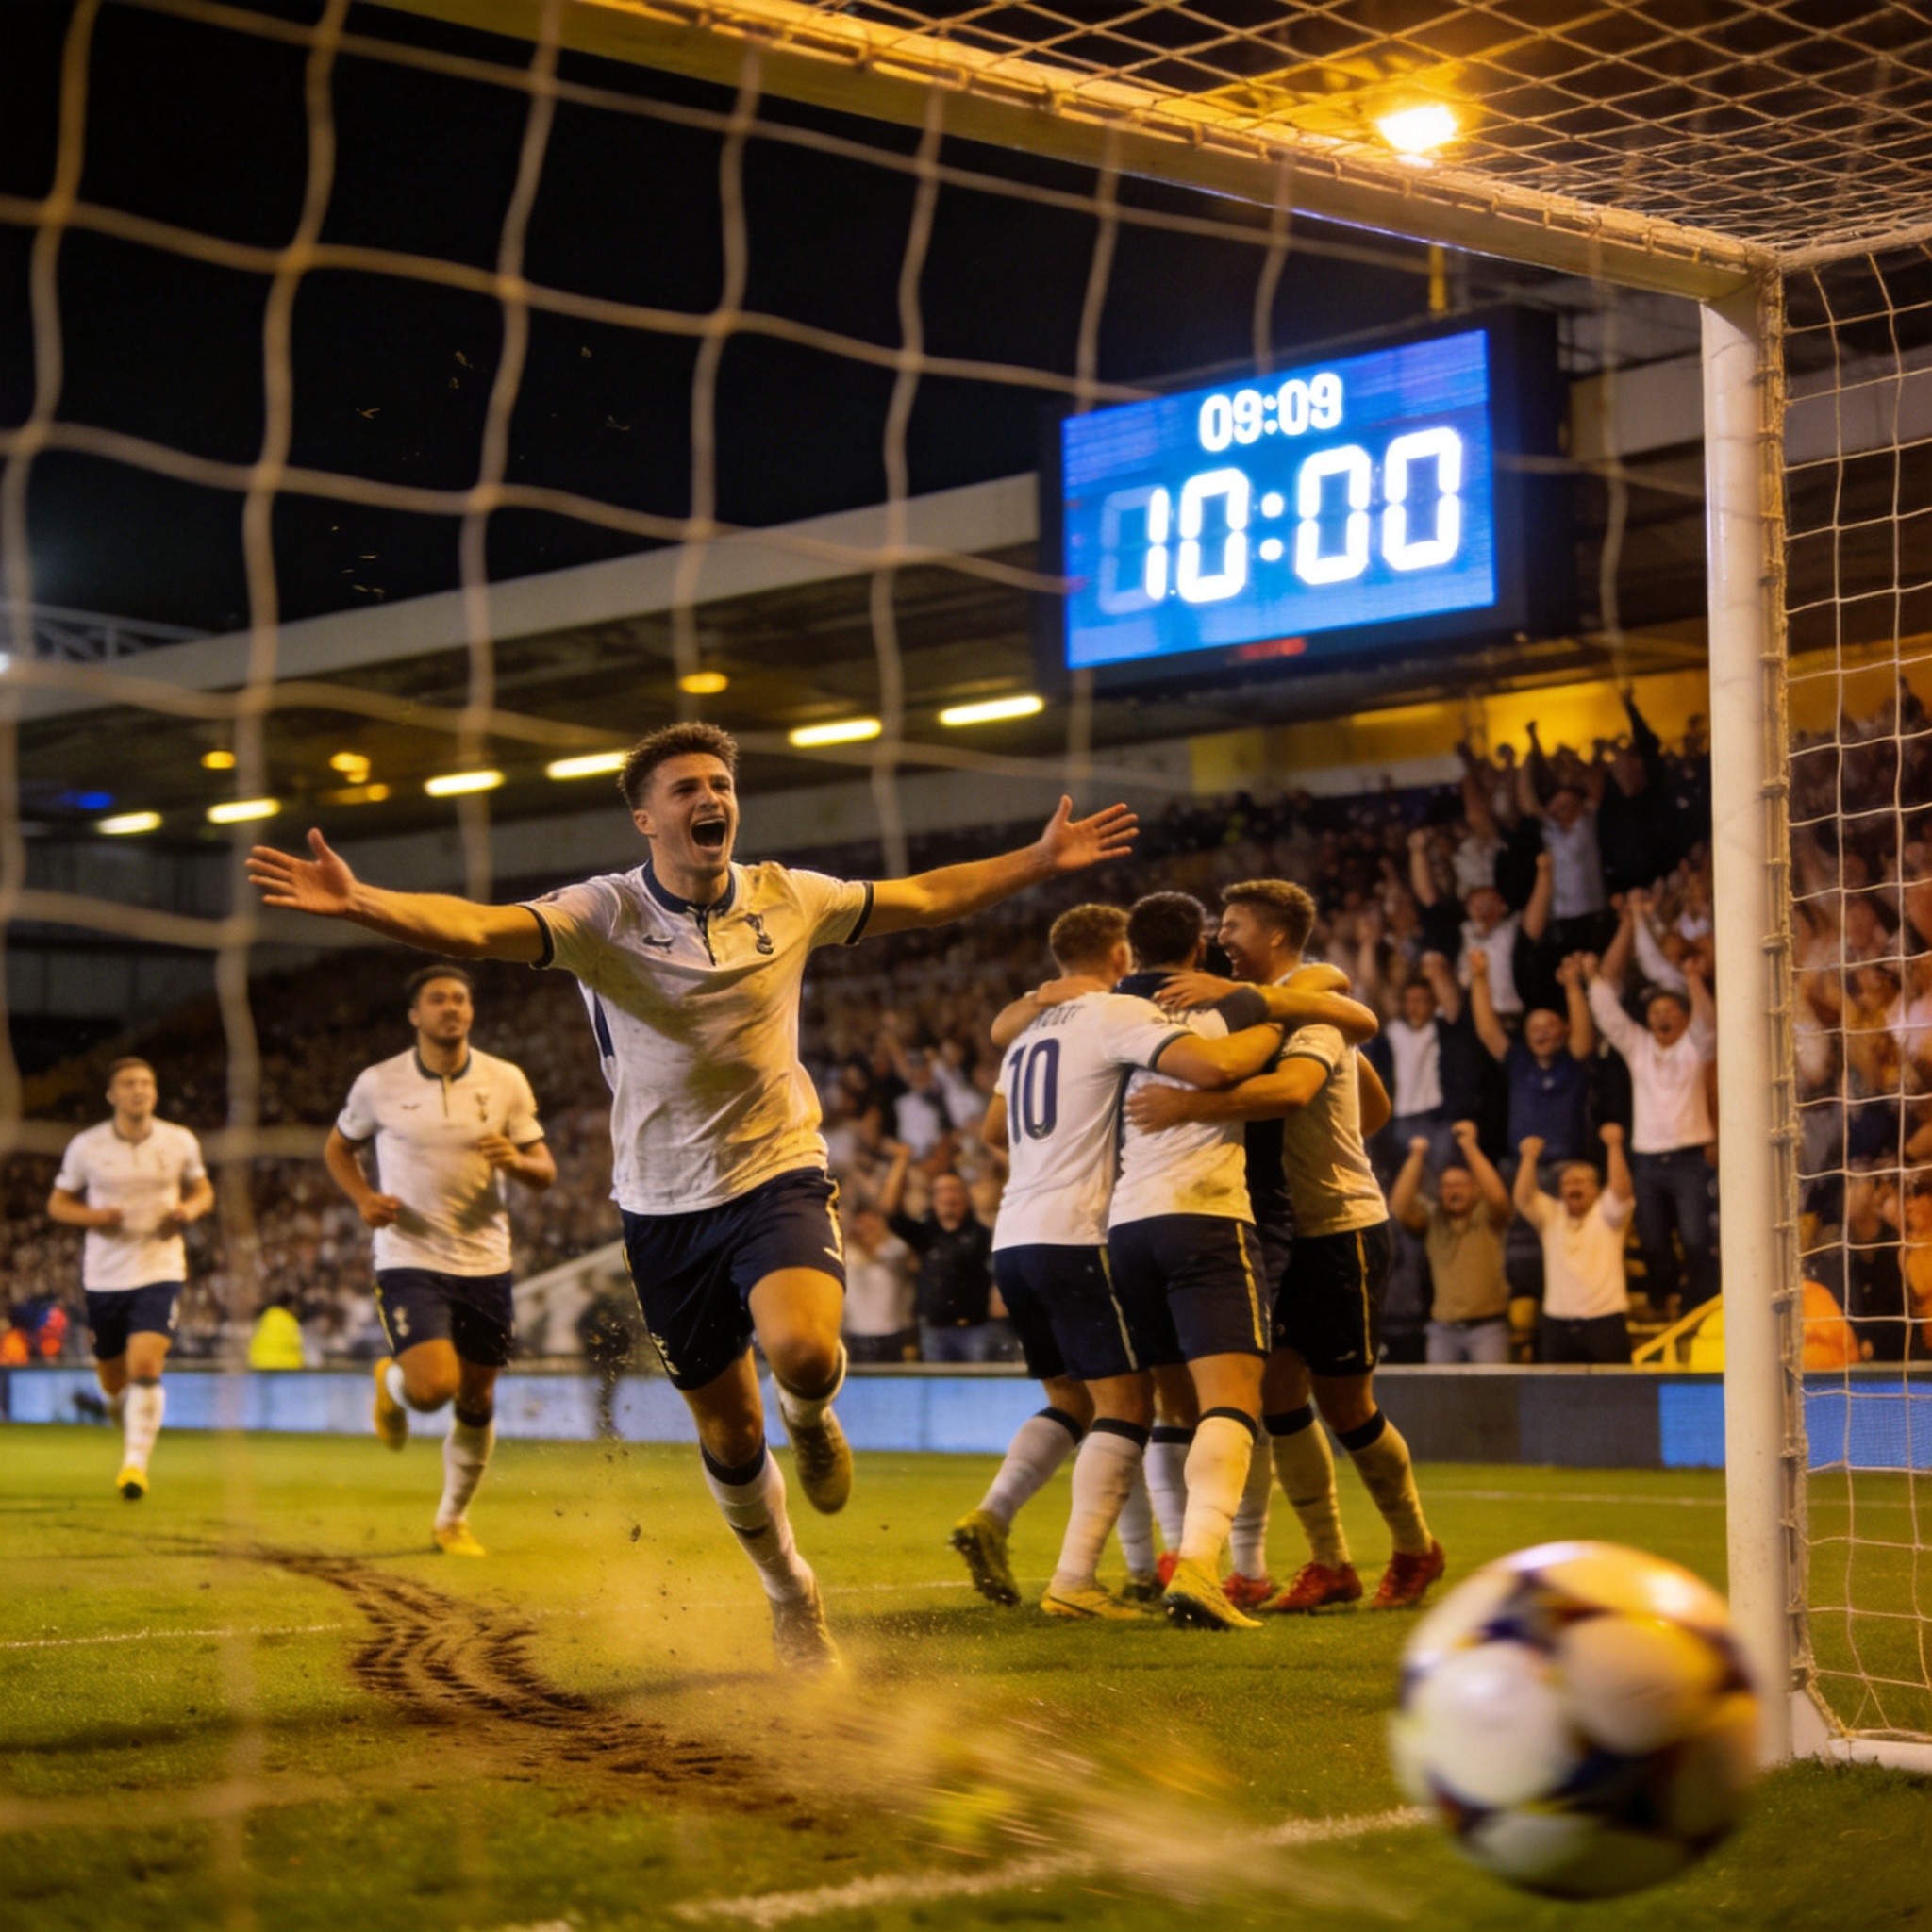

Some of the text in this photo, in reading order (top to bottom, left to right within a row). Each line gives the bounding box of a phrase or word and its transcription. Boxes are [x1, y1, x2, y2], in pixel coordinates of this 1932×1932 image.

[1199, 372, 1343, 452] 09:09
[1145, 426, 1462, 603] 10:00
[1008, 1037, 1059, 1145] 10
